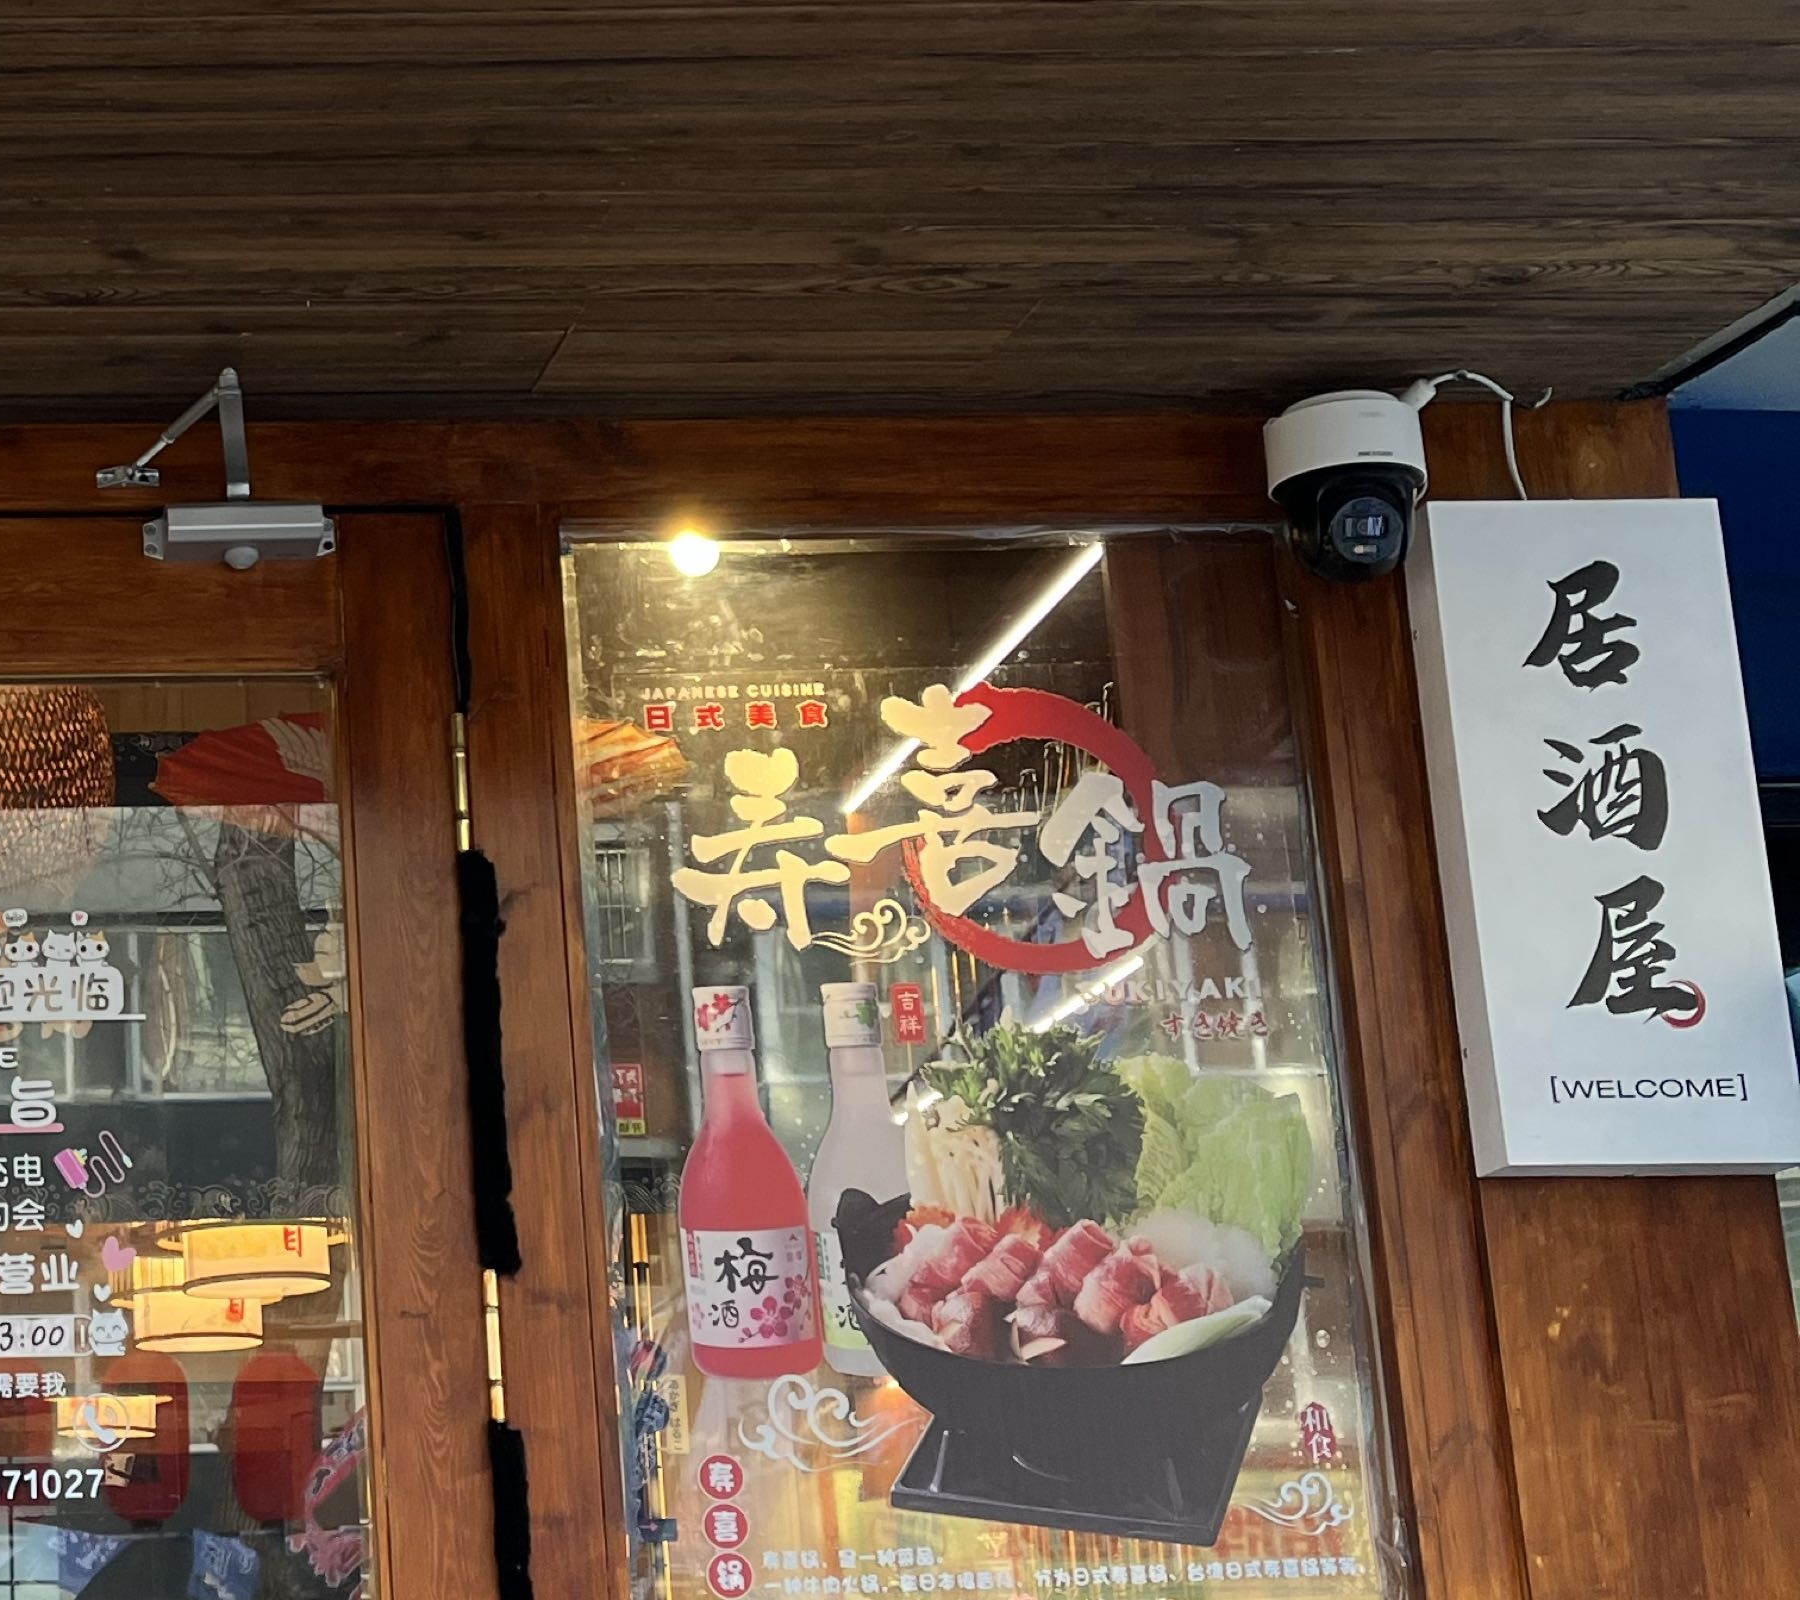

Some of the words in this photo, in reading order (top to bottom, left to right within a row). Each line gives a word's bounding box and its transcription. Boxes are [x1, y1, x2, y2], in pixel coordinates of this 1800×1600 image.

[641, 686, 740, 700] JAPANESE
[746, 682, 826, 698] CUISINE
[643, 699, 828, 733] 日式美食
[1522, 560, 1698, 1024] 居酒屋
[1080, 976, 1262, 1009] UKIYAKI
[897, 990, 924, 1037] 吉祥
[708, 1236, 780, 1330] 梅酒
